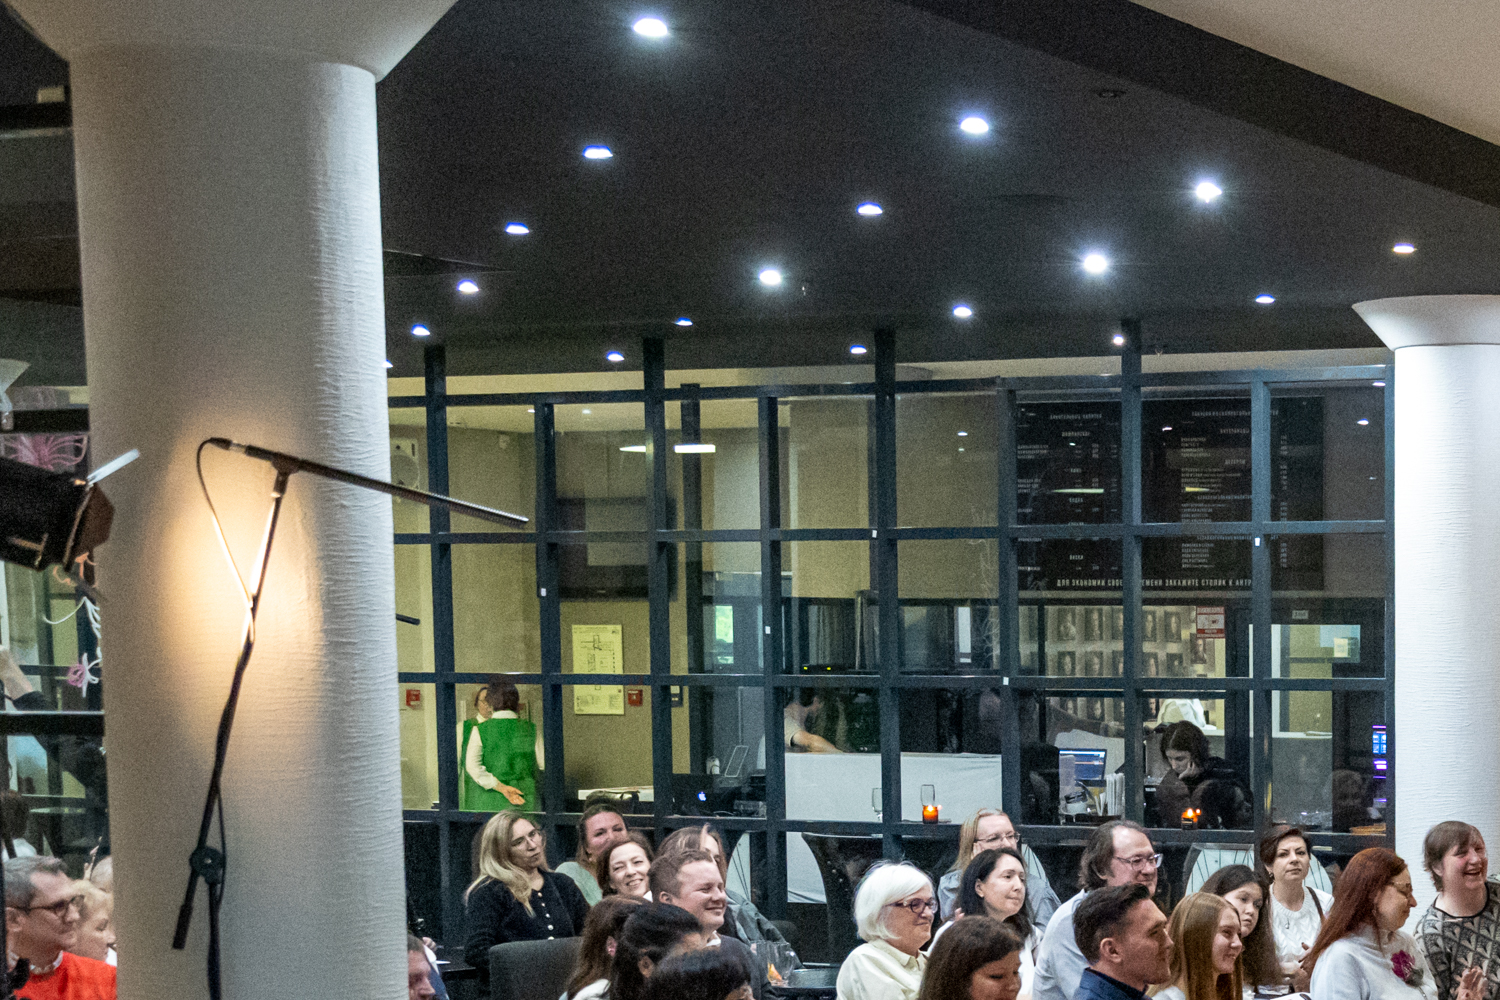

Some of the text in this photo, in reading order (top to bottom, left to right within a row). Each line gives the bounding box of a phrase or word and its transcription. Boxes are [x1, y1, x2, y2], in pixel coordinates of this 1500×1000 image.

[1056, 579, 1070, 587] ДЛЯ
[1071, 579, 1105, 587] ЭКОНОМИИ
[1165, 579, 1199, 587] ЗАКАЖИТЕ
